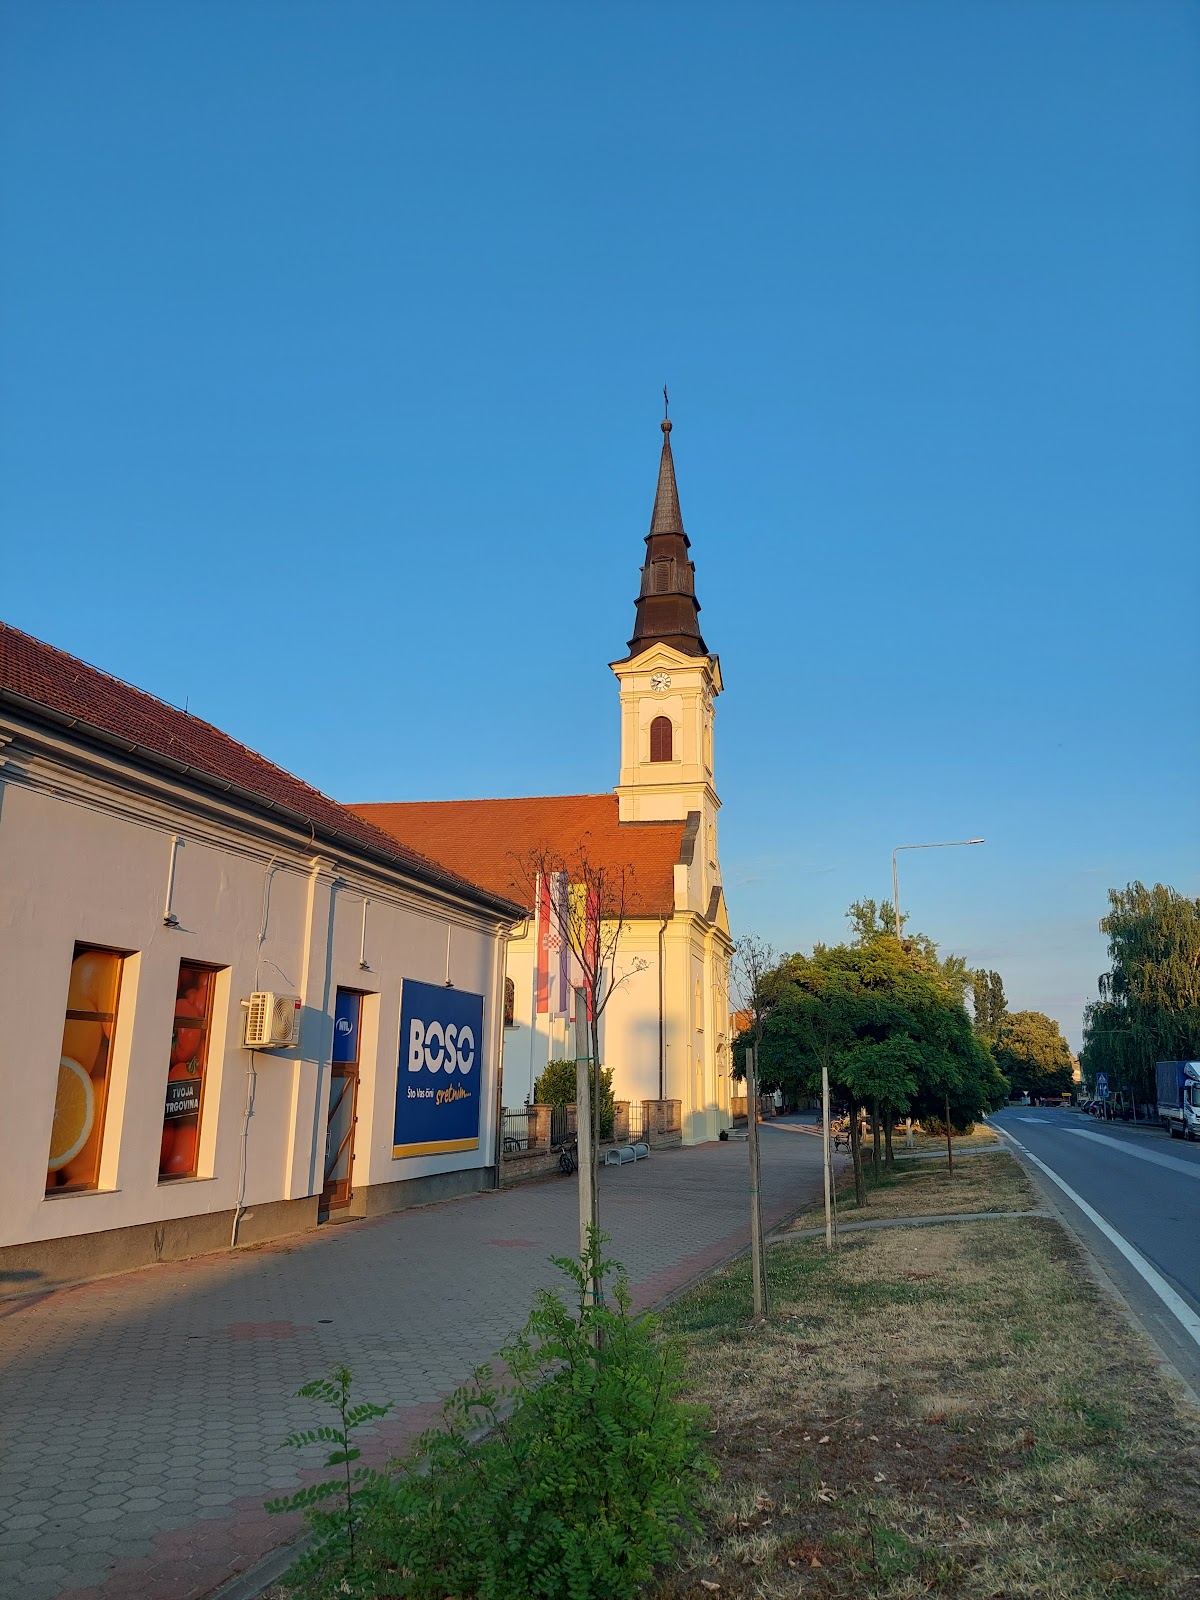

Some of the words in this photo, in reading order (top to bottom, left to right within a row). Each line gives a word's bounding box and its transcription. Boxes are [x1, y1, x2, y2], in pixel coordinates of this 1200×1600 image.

[408, 1018, 475, 1075] BOSO
[173, 1086, 193, 1098] TVOJA
[407, 1085, 416, 1099] Što
[416, 1087, 425, 1098] Vas
[166, 1099, 198, 1113] TRGOVINA
